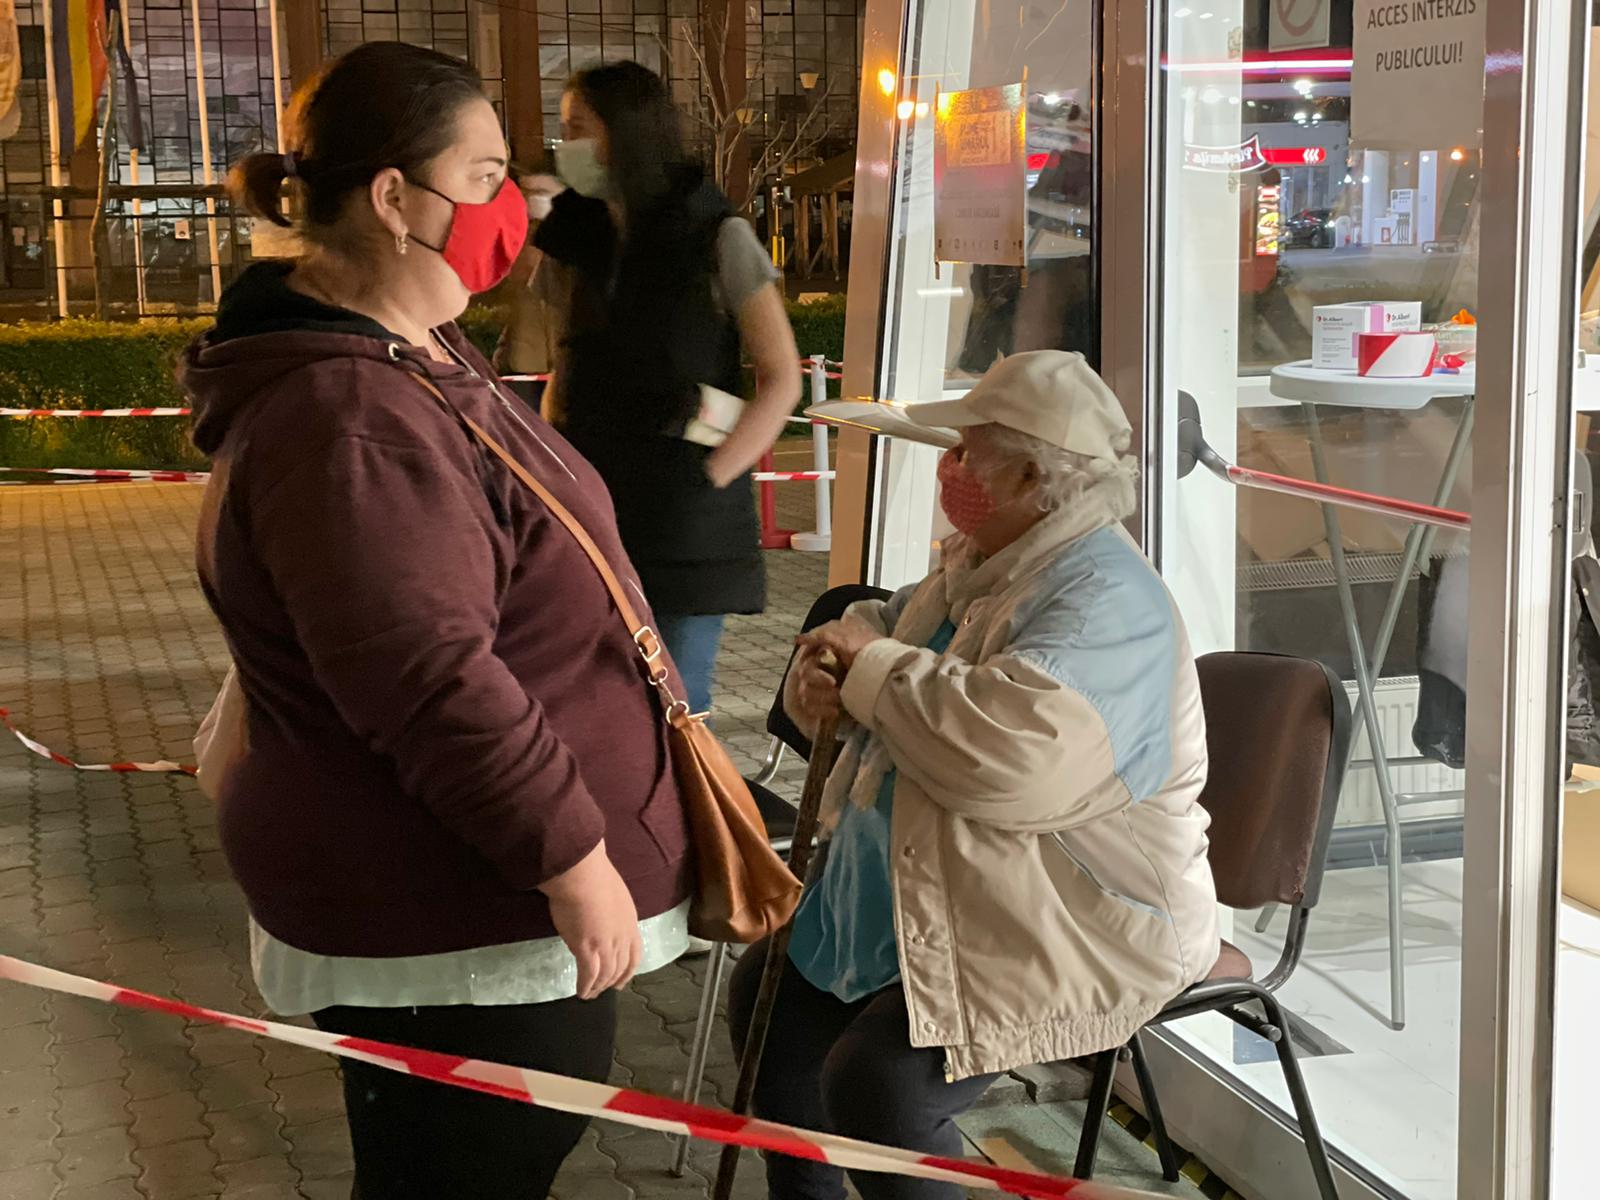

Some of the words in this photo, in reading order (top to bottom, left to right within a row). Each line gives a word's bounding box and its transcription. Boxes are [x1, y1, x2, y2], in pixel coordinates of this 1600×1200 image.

[1367, 4, 1408, 29] ACCES
[1412, 0, 1476, 22] INTERZIS
[1376, 41, 1463, 72] PUBLICULUI!
